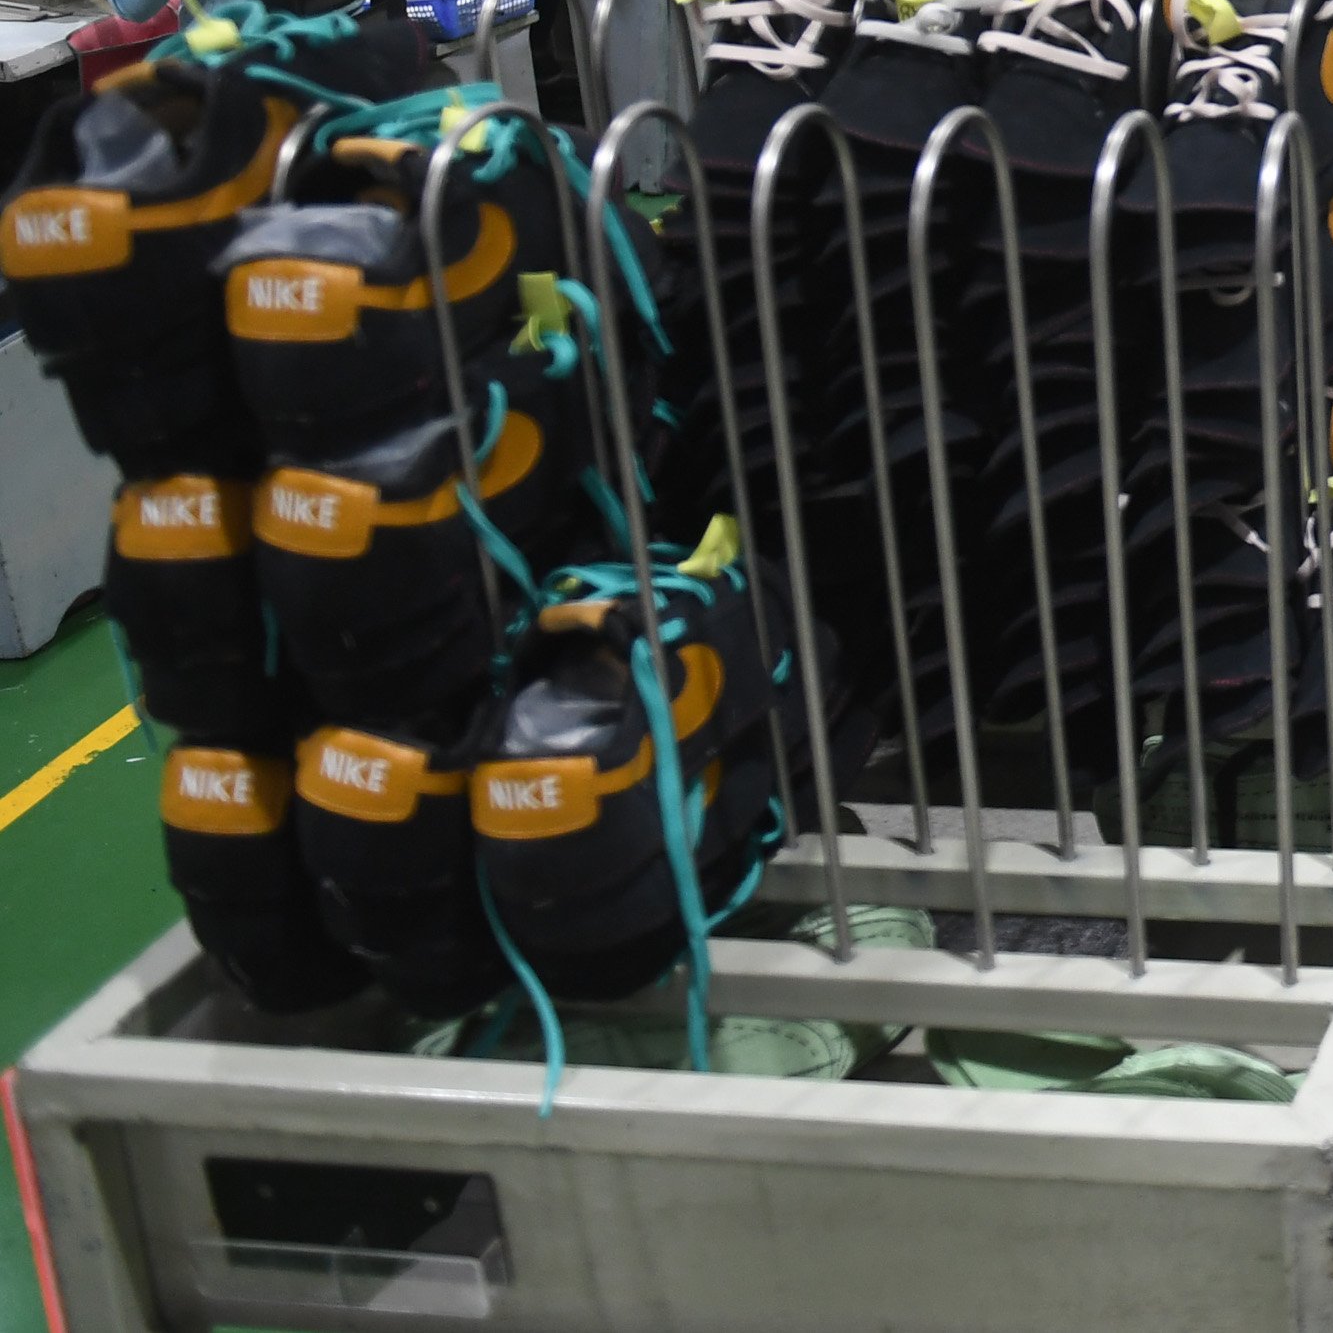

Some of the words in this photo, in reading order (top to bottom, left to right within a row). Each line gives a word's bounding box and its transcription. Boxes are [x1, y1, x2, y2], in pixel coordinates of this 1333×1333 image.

[14, 208, 92, 247] NIKE
[247, 275, 325, 315] NIKE
[140, 490, 221, 529] NIKE
[271, 484, 342, 530] NIKE
[179, 766, 255, 805] NIKE
[319, 746, 391, 793] NIKE
[487, 774, 563, 811] NIKE
